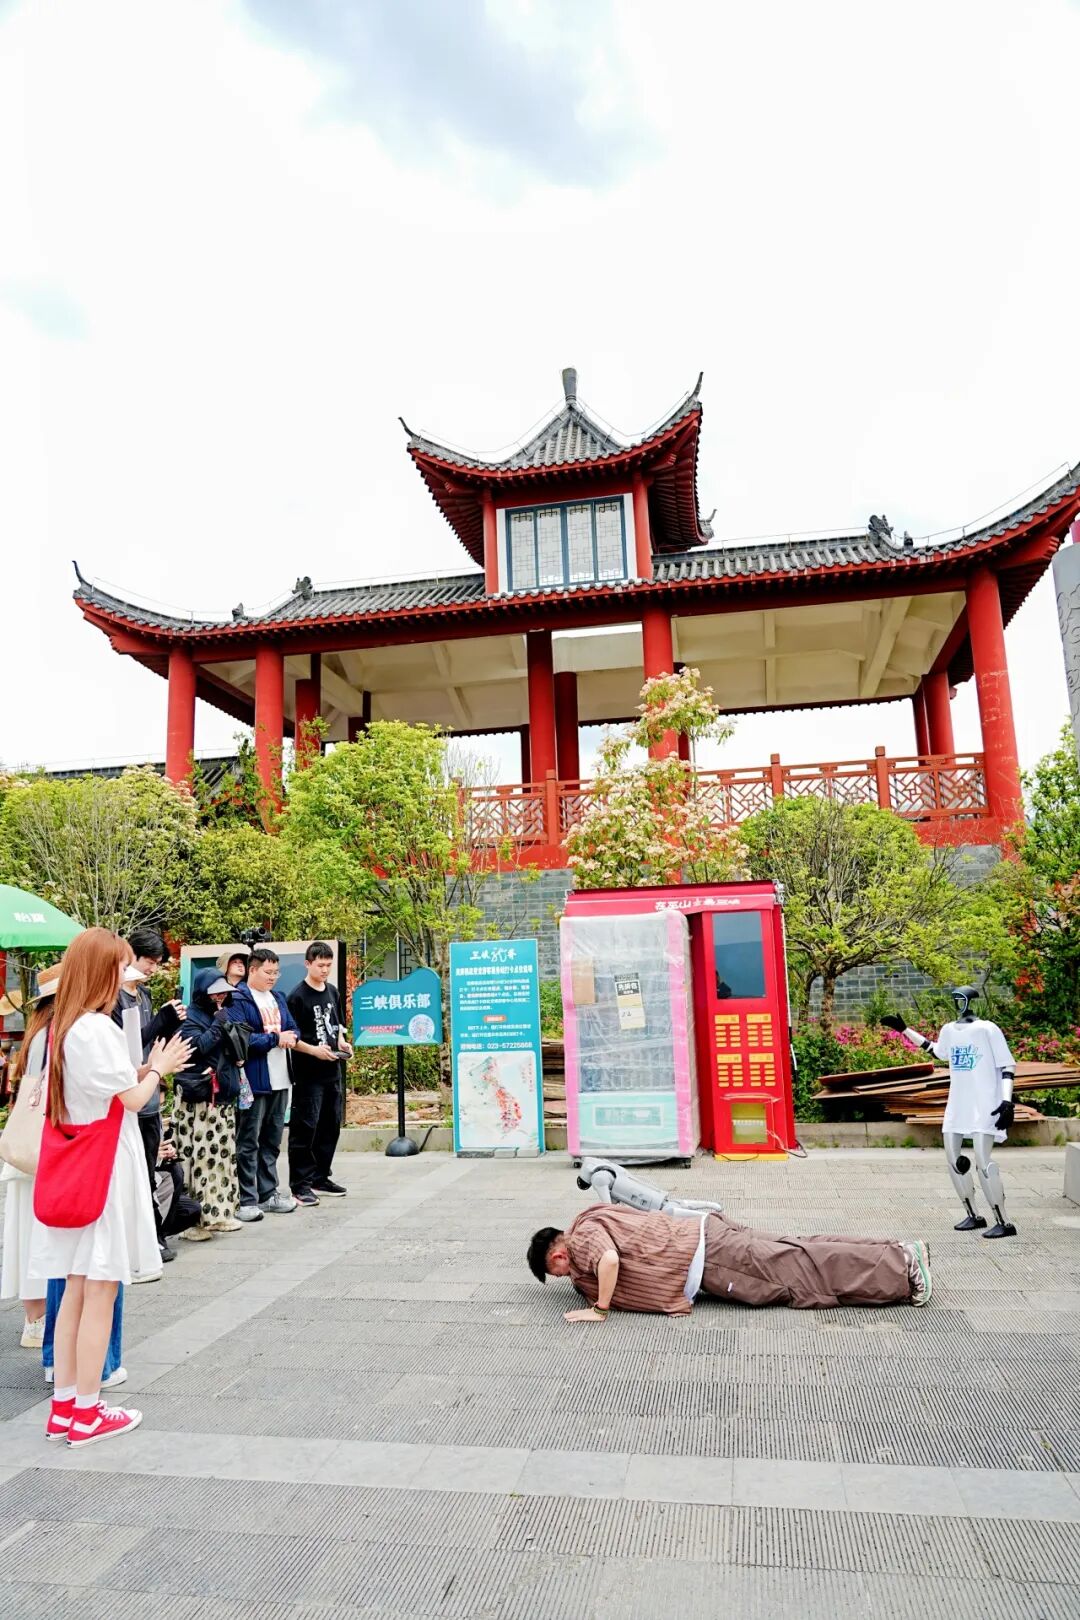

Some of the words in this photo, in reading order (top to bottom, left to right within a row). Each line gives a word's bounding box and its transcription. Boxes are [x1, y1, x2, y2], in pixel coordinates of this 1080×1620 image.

[360, 993, 431, 1010] 三峡俱乐部
